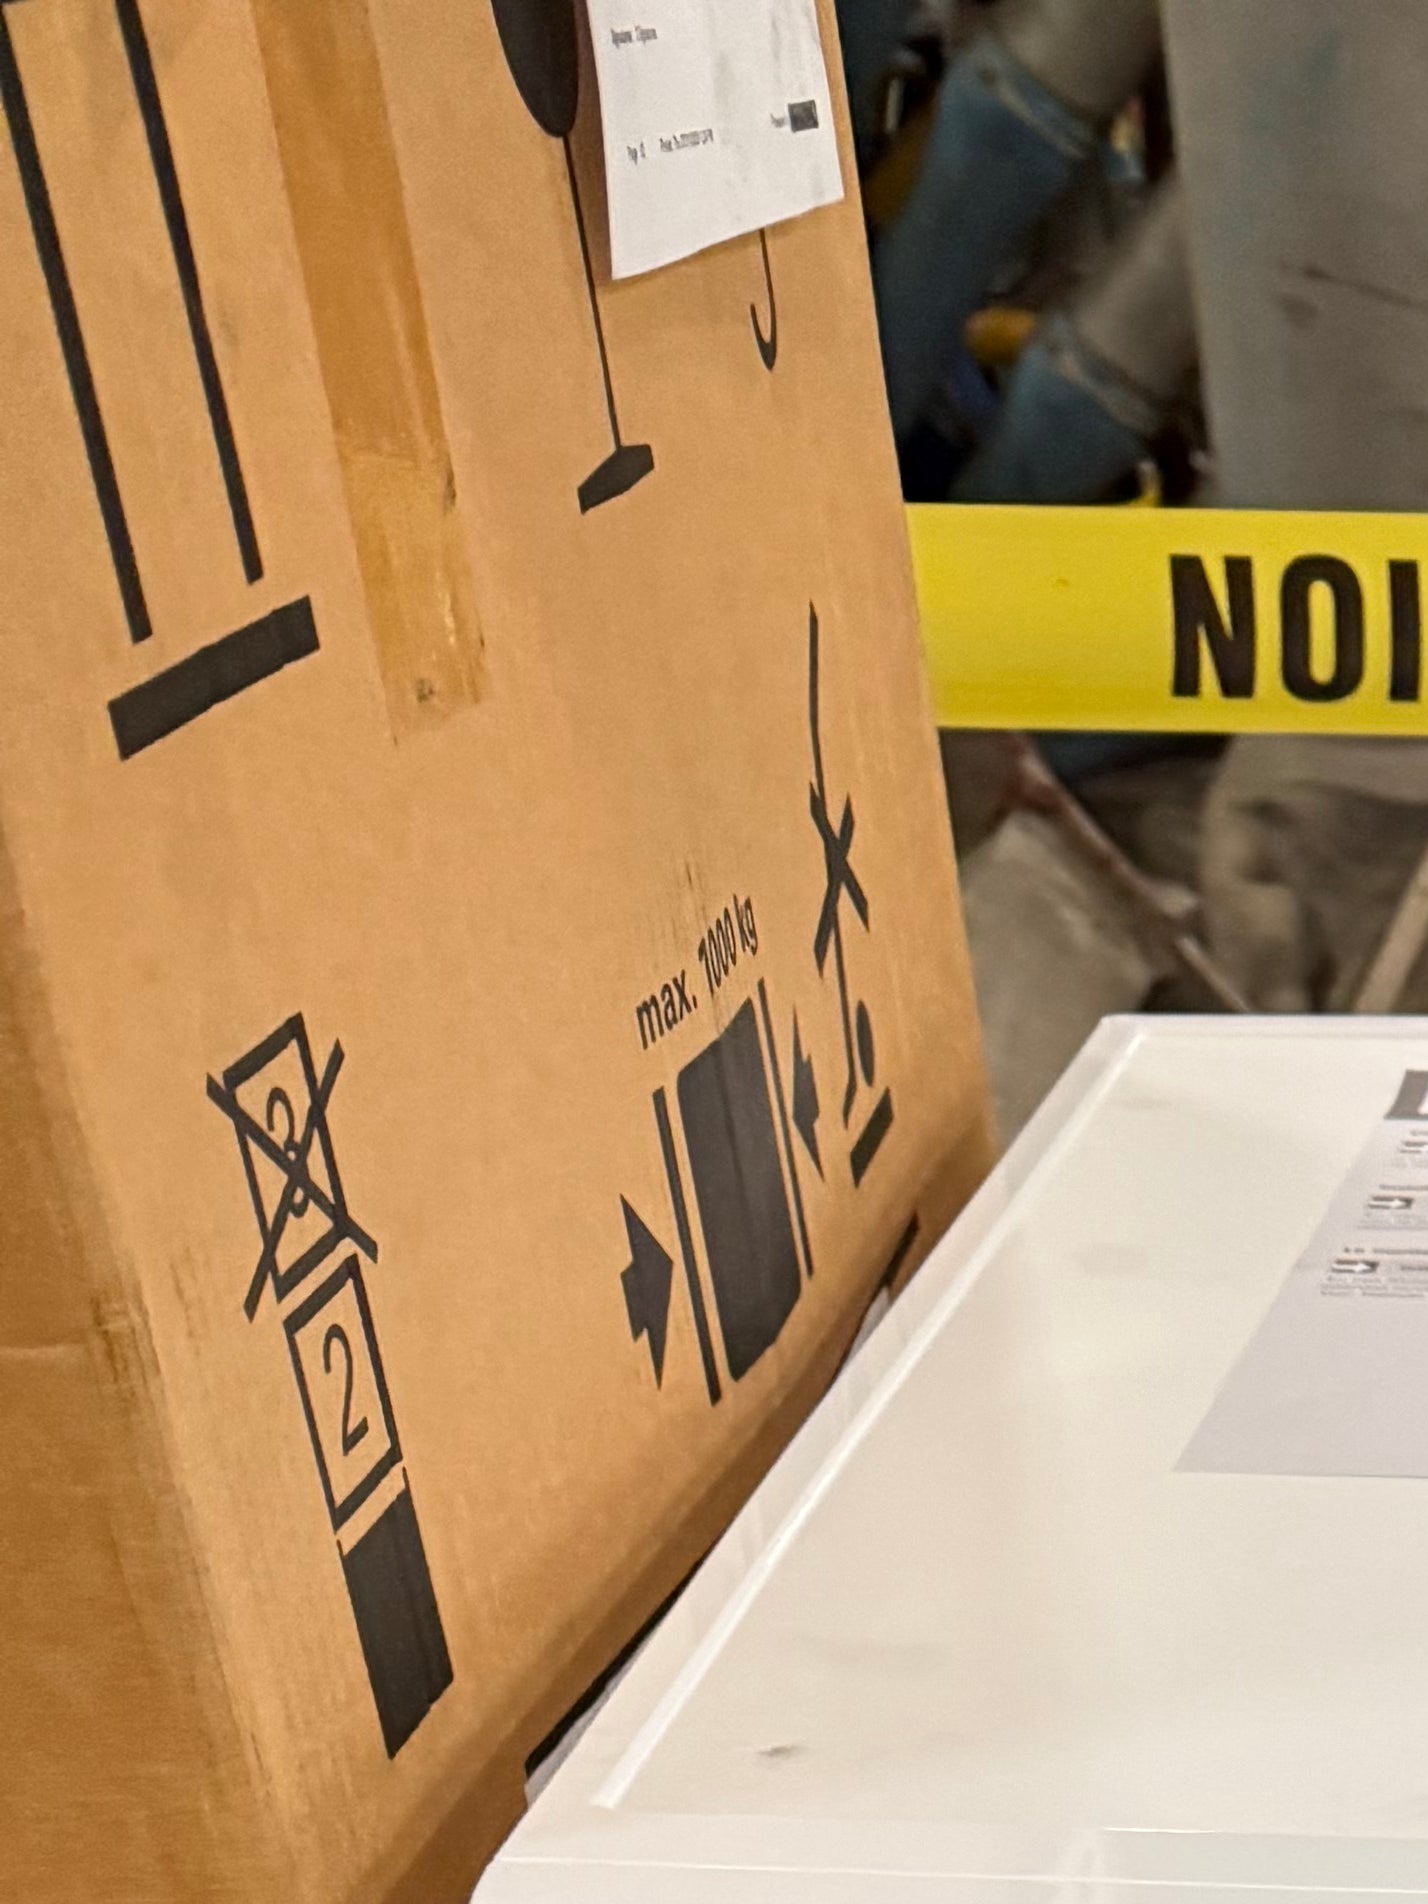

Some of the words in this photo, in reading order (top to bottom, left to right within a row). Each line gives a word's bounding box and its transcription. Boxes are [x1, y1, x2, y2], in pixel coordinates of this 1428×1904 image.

[636, 969, 698, 1050] max.
[698, 907, 737, 998] 1000
[733, 893, 758, 956] kg
[321, 1322, 369, 1457] 2
